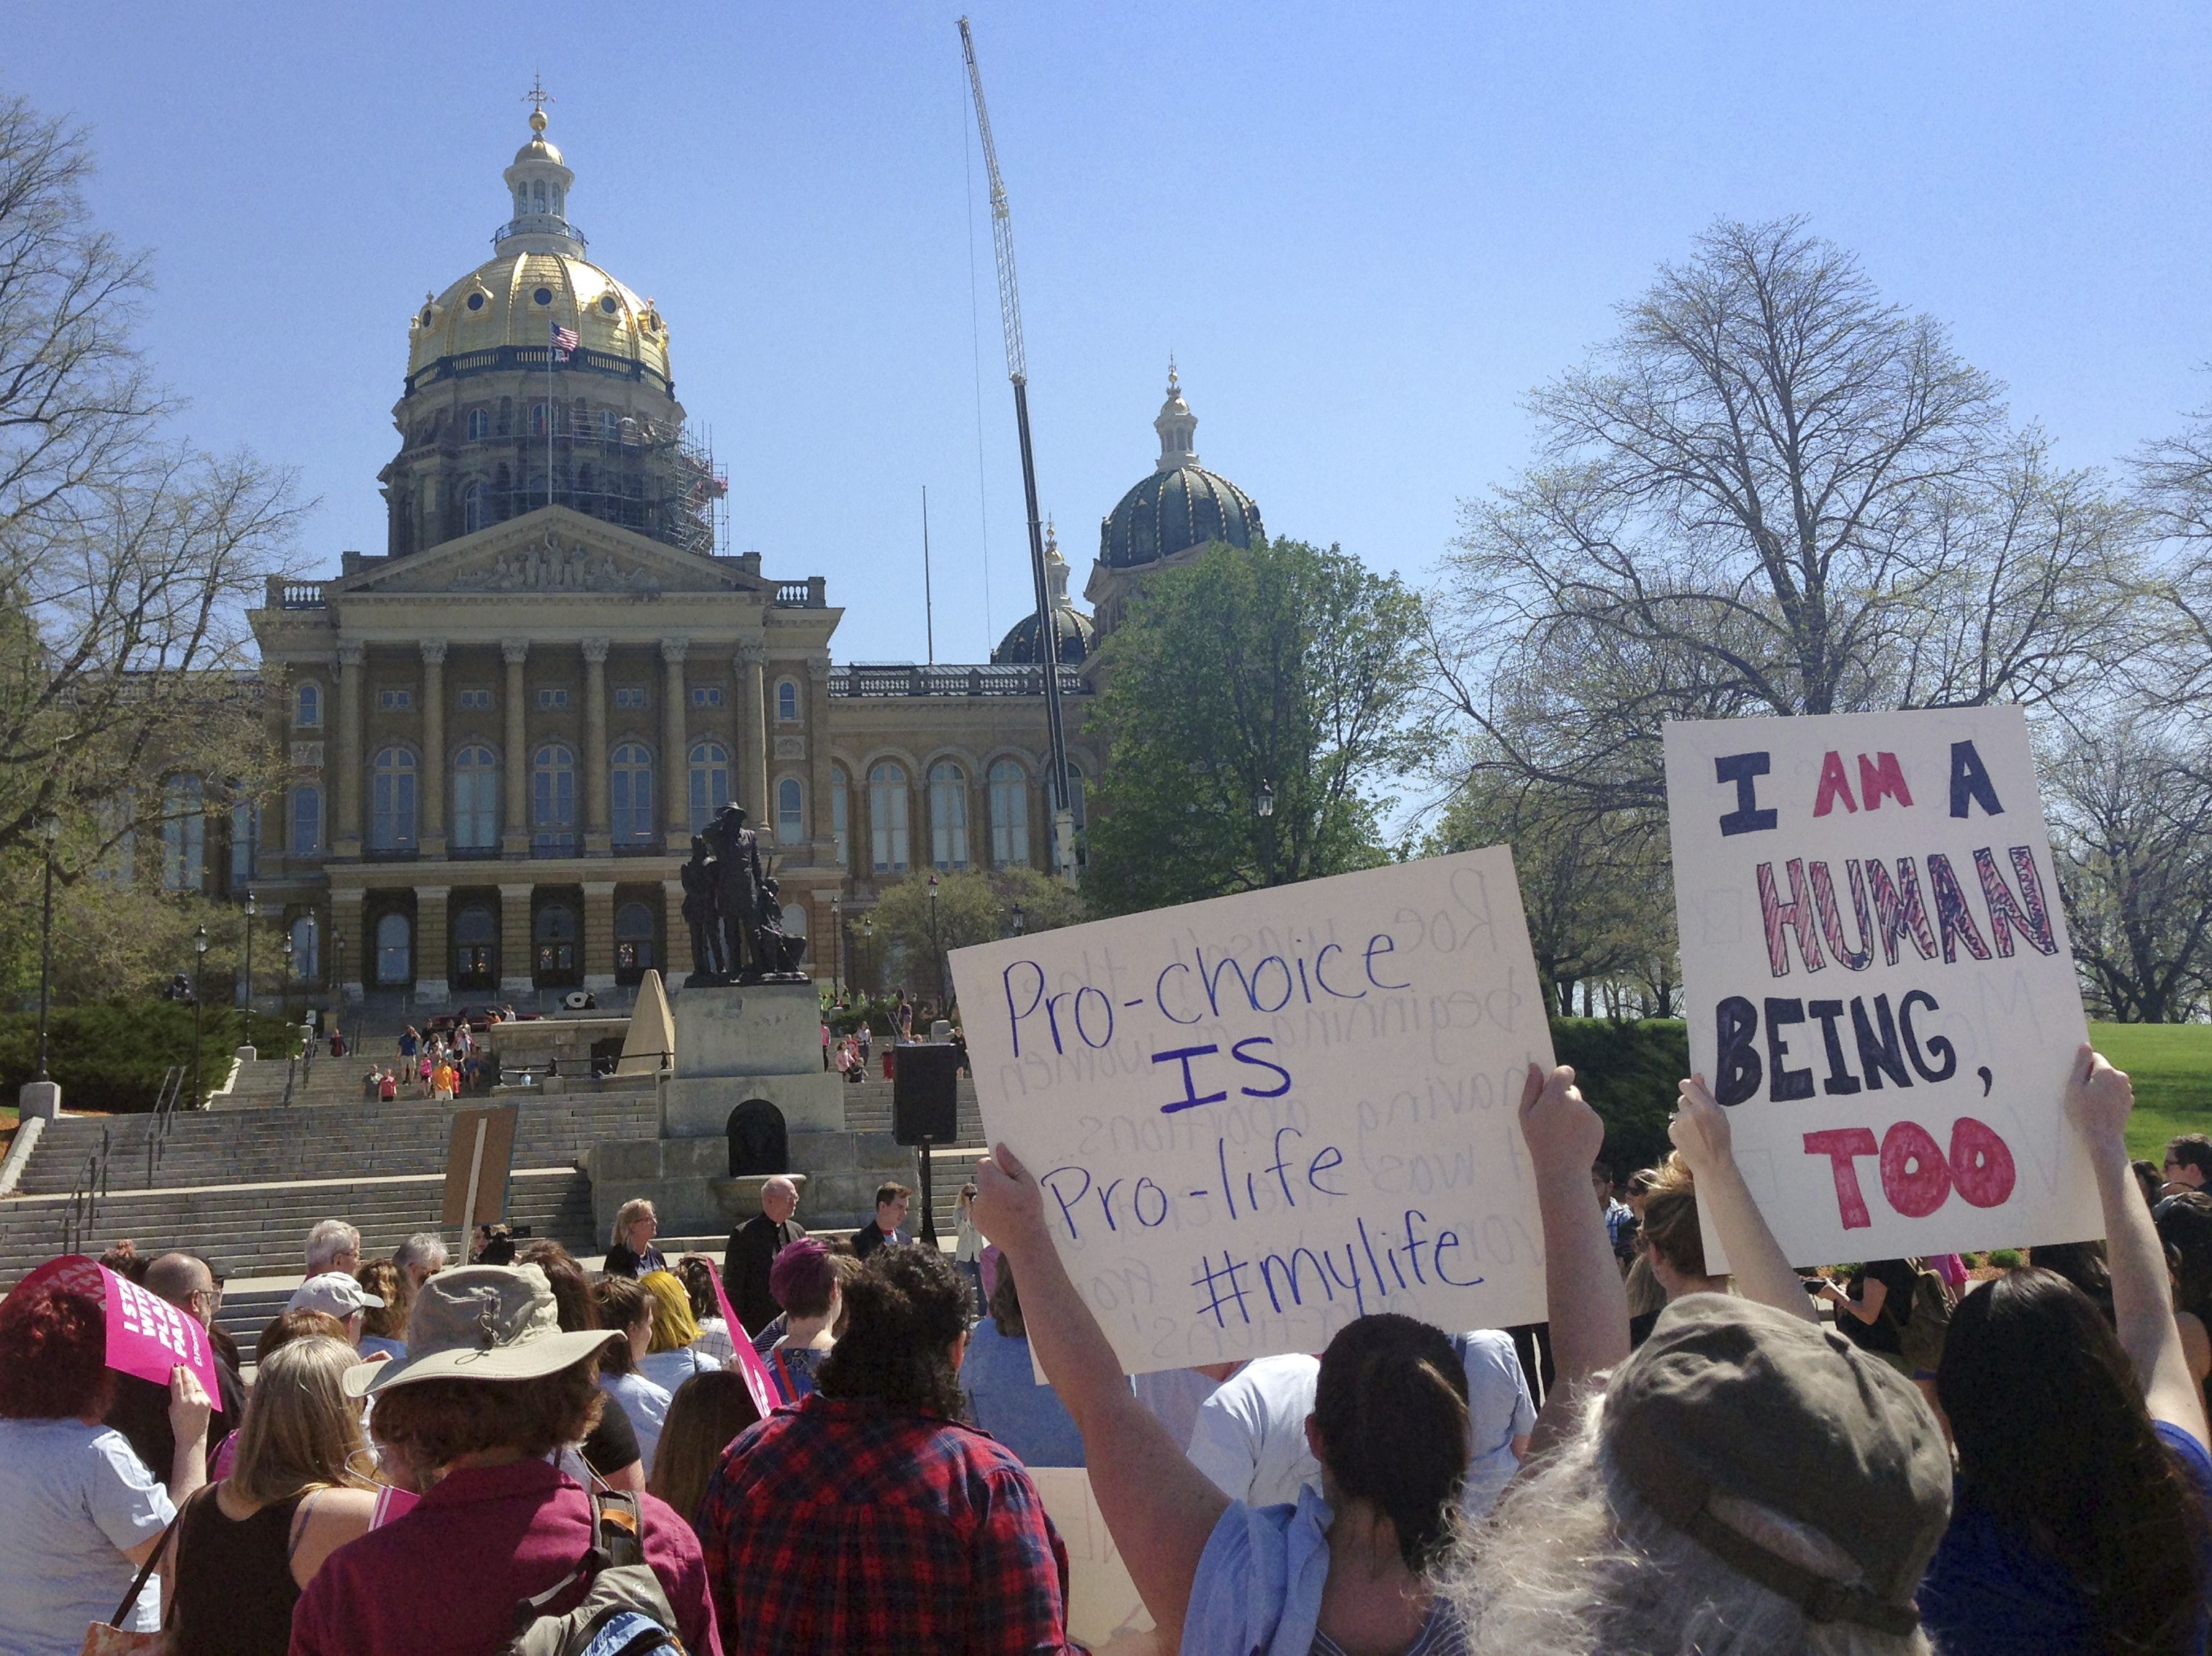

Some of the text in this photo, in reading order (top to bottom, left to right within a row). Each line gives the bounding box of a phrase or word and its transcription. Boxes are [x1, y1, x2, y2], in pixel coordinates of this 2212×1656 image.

[1714, 750, 1779, 838] I
[1812, 750, 1915, 819] AM
[1948, 739, 2006, 820] A
[1756, 845, 2060, 978] HUMAN
[1002, 932, 1412, 1059] Pro-choice
[1713, 989, 1993, 1108] BEING,
[1151, 1036, 1292, 1115] IS
[1040, 1128, 1350, 1240] Pro-life
[1802, 1116, 2018, 1231] TOO
[108, 1269, 138, 1320] STA
[1189, 1209, 1486, 1331] #mylife
